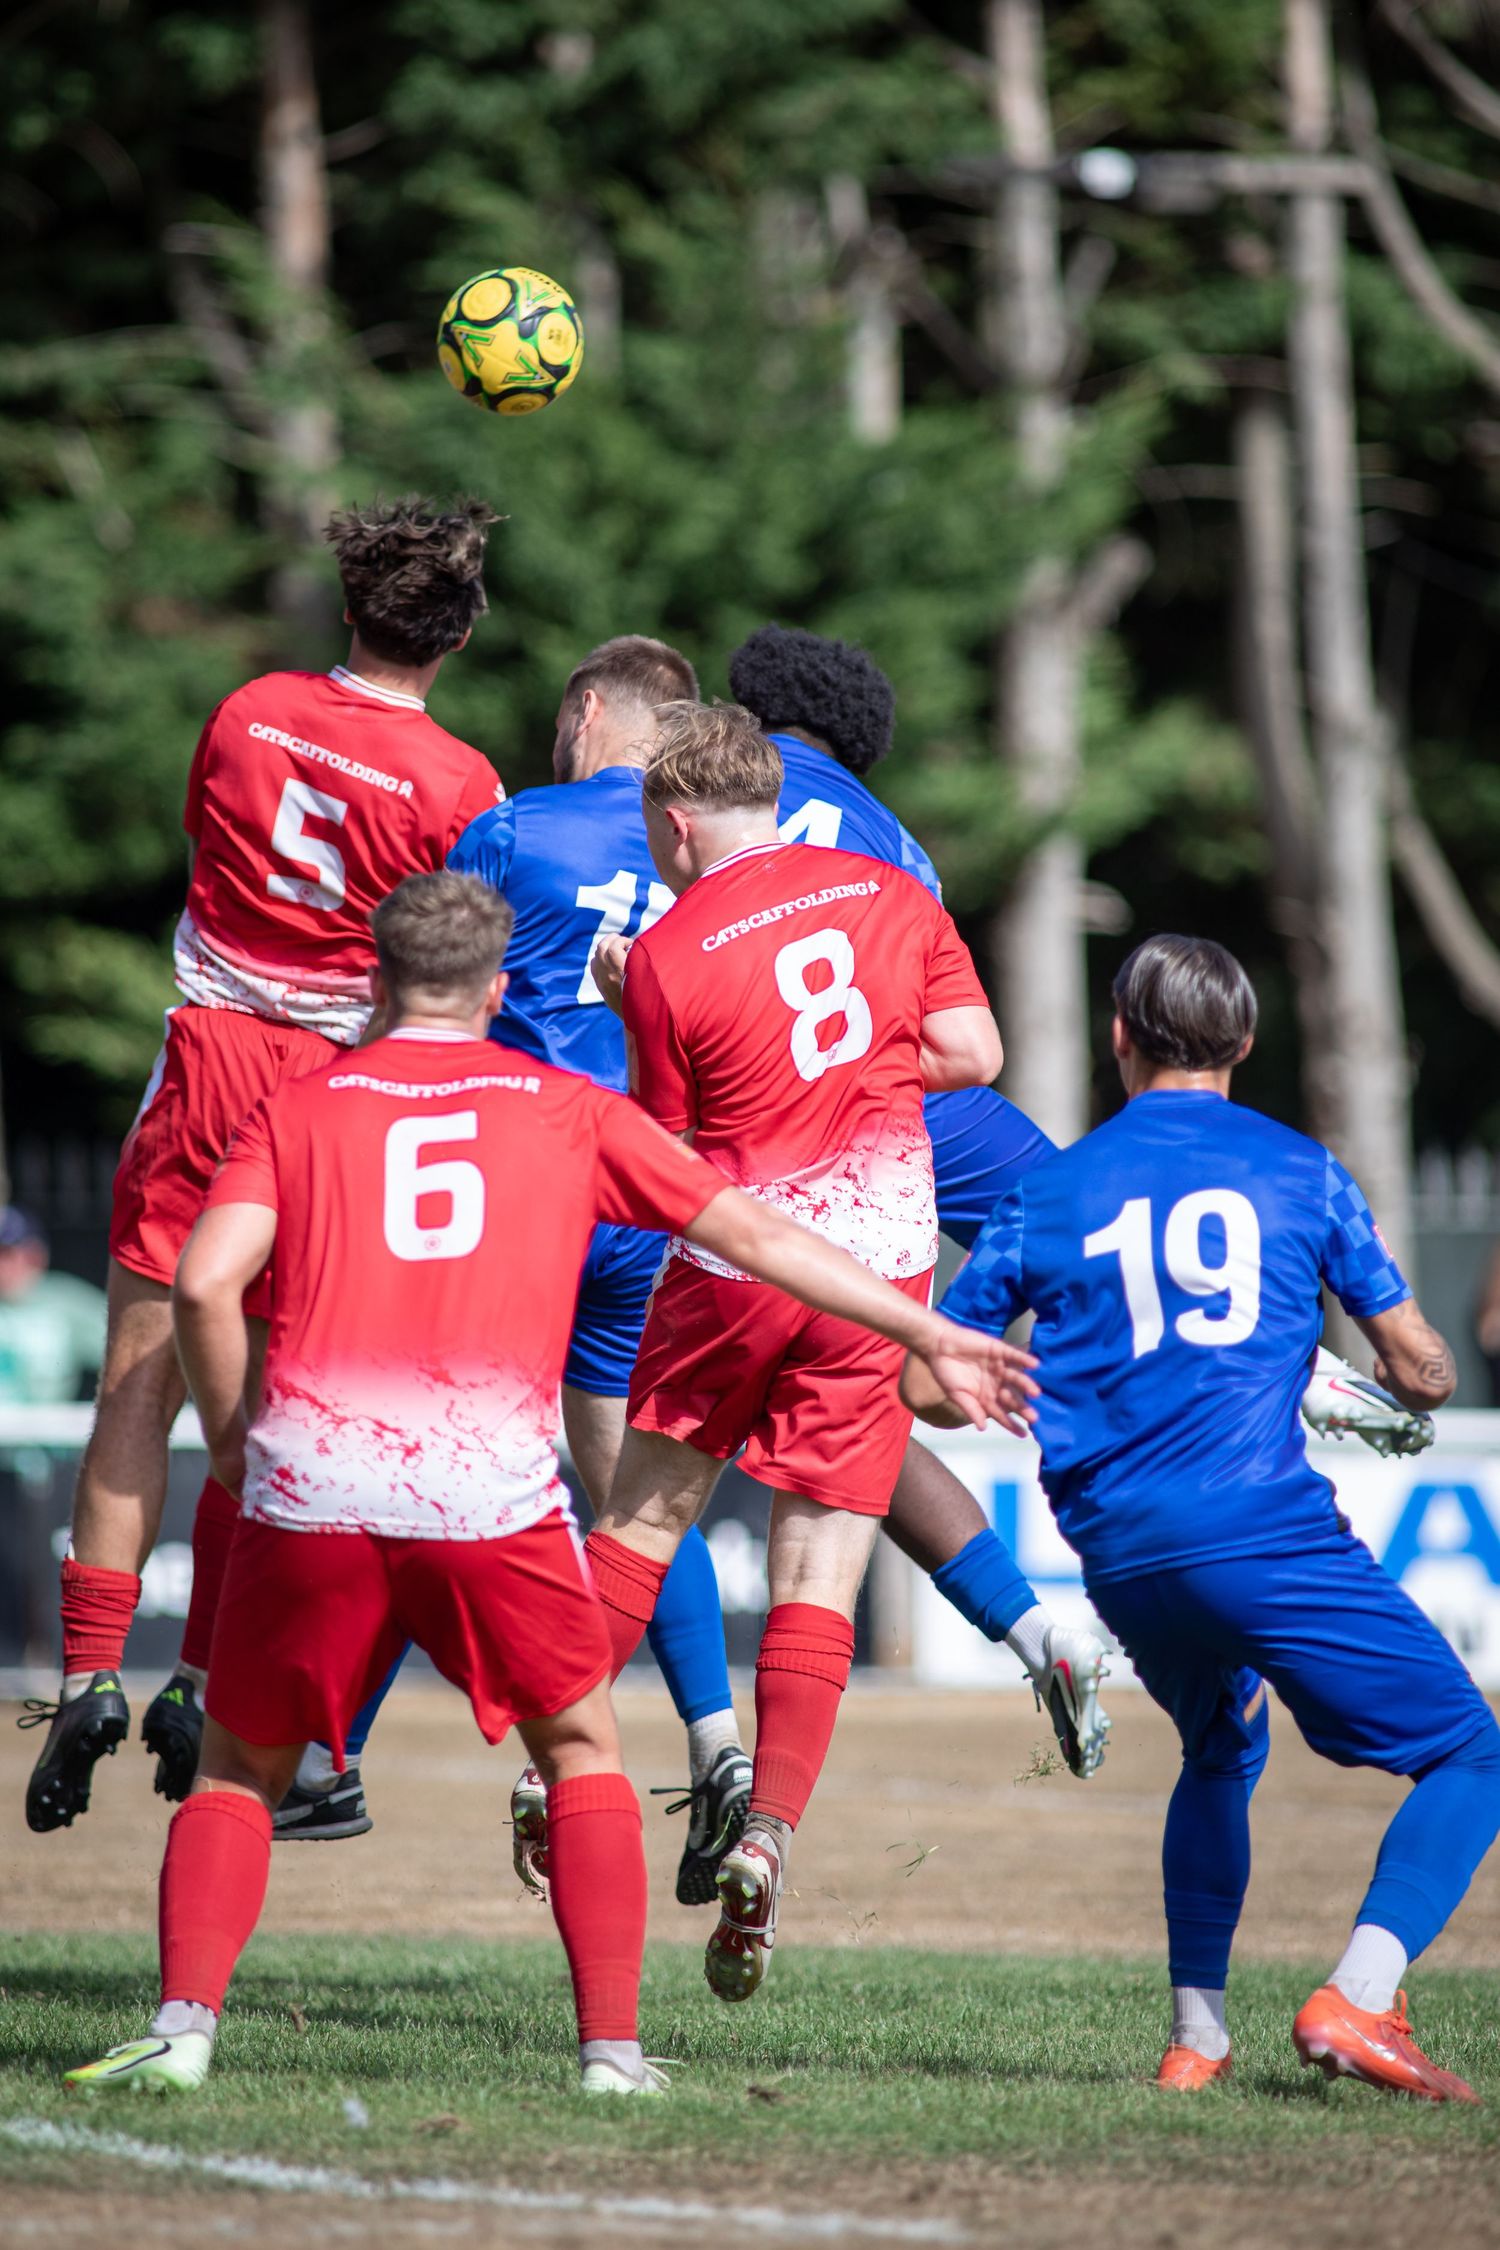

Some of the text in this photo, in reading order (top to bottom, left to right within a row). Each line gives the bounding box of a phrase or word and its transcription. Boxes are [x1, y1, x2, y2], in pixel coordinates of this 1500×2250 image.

[267, 777, 348, 912] 5
[775, 928, 873, 1083] 8
[383, 1110, 486, 1262] 6
[1083, 1188, 1261, 1360] 19
